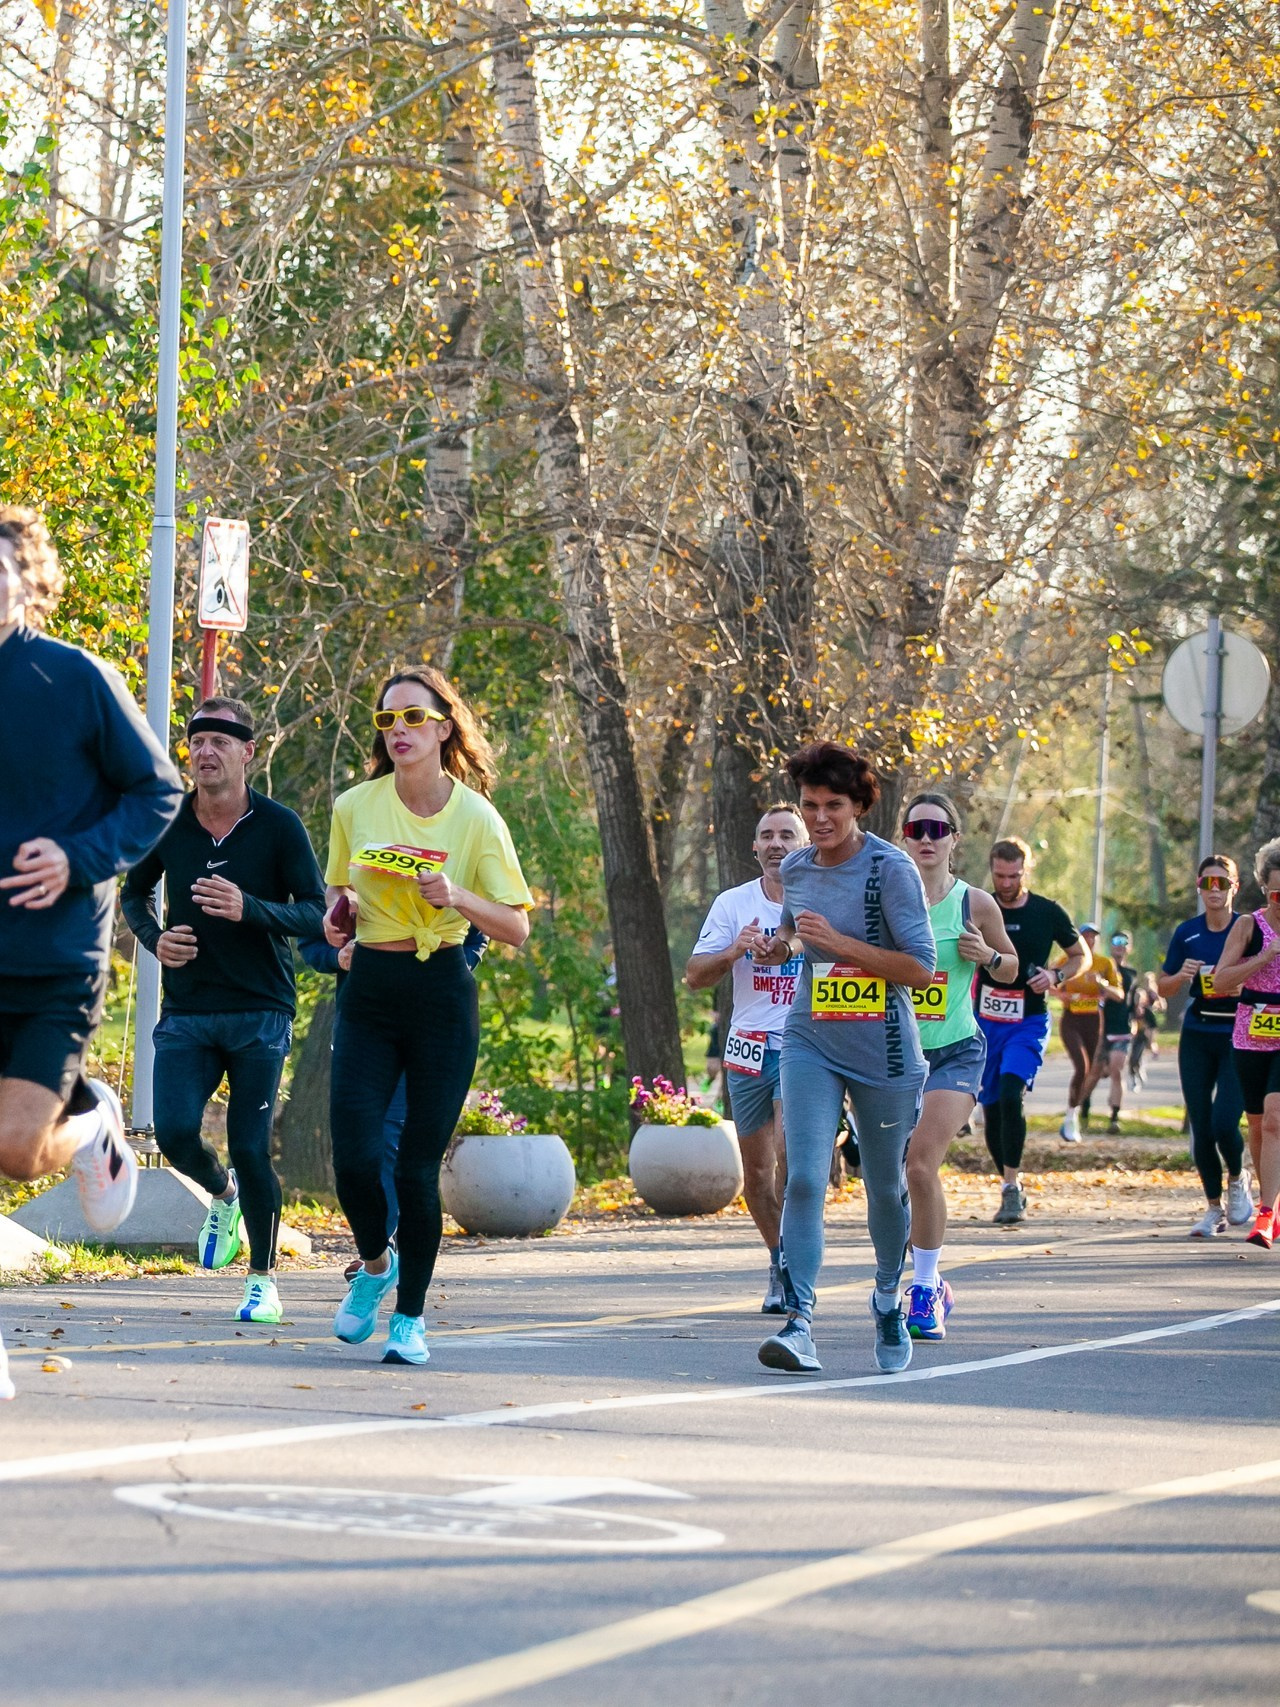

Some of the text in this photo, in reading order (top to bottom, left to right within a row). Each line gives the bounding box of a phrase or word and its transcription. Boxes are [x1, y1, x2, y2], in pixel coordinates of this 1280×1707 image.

[359, 849, 435, 874] 5996
[864, 855, 884, 947] INNER#1
[753, 975, 797, 992] ВМЕСТЕ
[816, 980, 880, 1003] 5104
[983, 996, 1019, 1014] 5871
[726, 1036, 762, 1062] 5906
